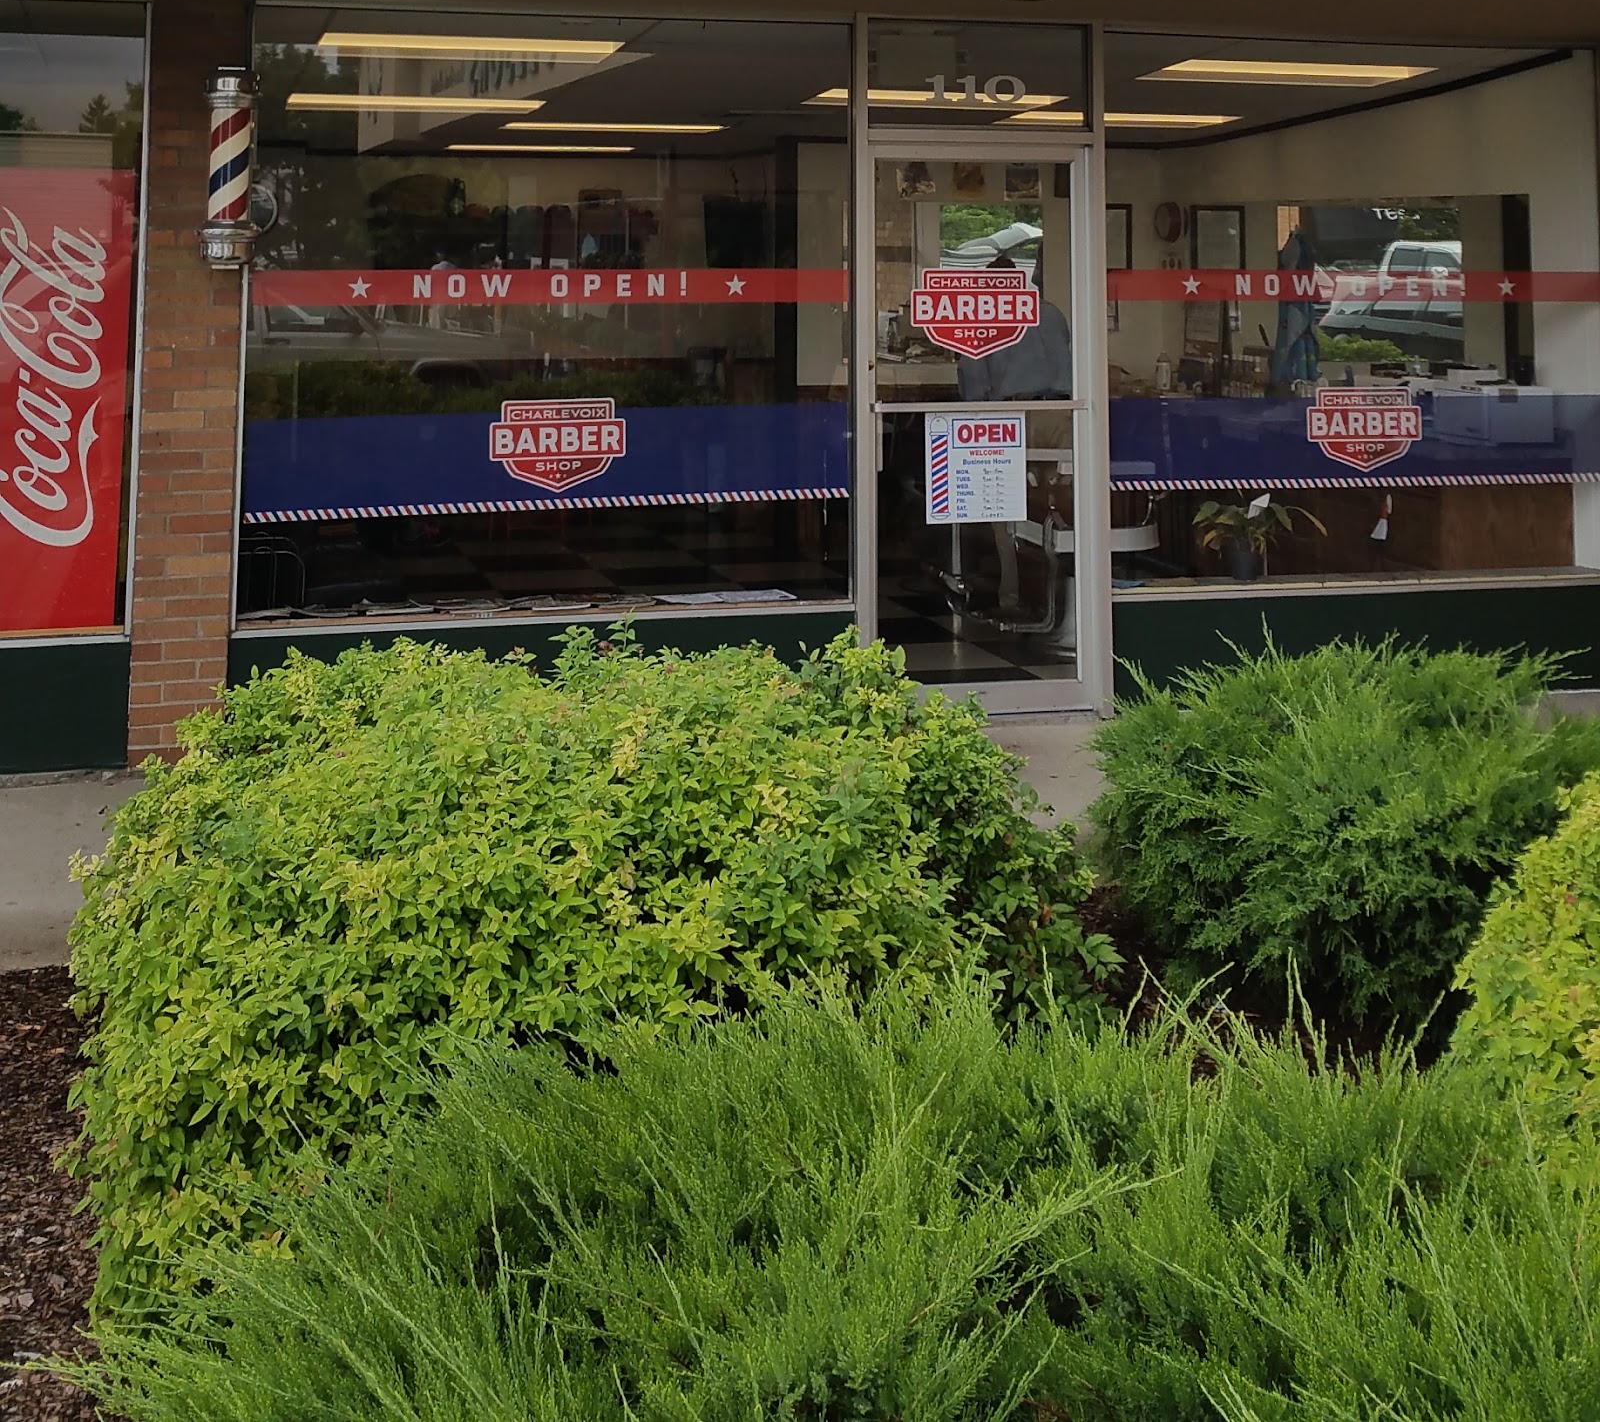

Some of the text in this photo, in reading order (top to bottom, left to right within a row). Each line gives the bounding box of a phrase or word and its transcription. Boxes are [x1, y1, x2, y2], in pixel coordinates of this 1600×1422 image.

[925, 74, 1026, 106] 110
[412, 270, 688, 298] NOW OPEN!
[930, 277, 1020, 288] CHARLEVOIX
[1235, 273, 1317, 297] NOW
[915, 294, 1035, 321] BARBER
[953, 328, 998, 339] SHOP
[1324, 396, 1404, 405] CHARLEVOIX
[510, 407, 606, 421] CHARLEVOIX
[1311, 411, 1418, 437] BARBER
[495, 424, 621, 455] BARBER
[957, 423, 1017, 444] OPEN
[969, 449, 1005, 457] WELCOME!
[1345, 443, 1386, 453] SHOP
[535, 460, 582, 472] SHOP
[962, 458, 992, 466] Business
